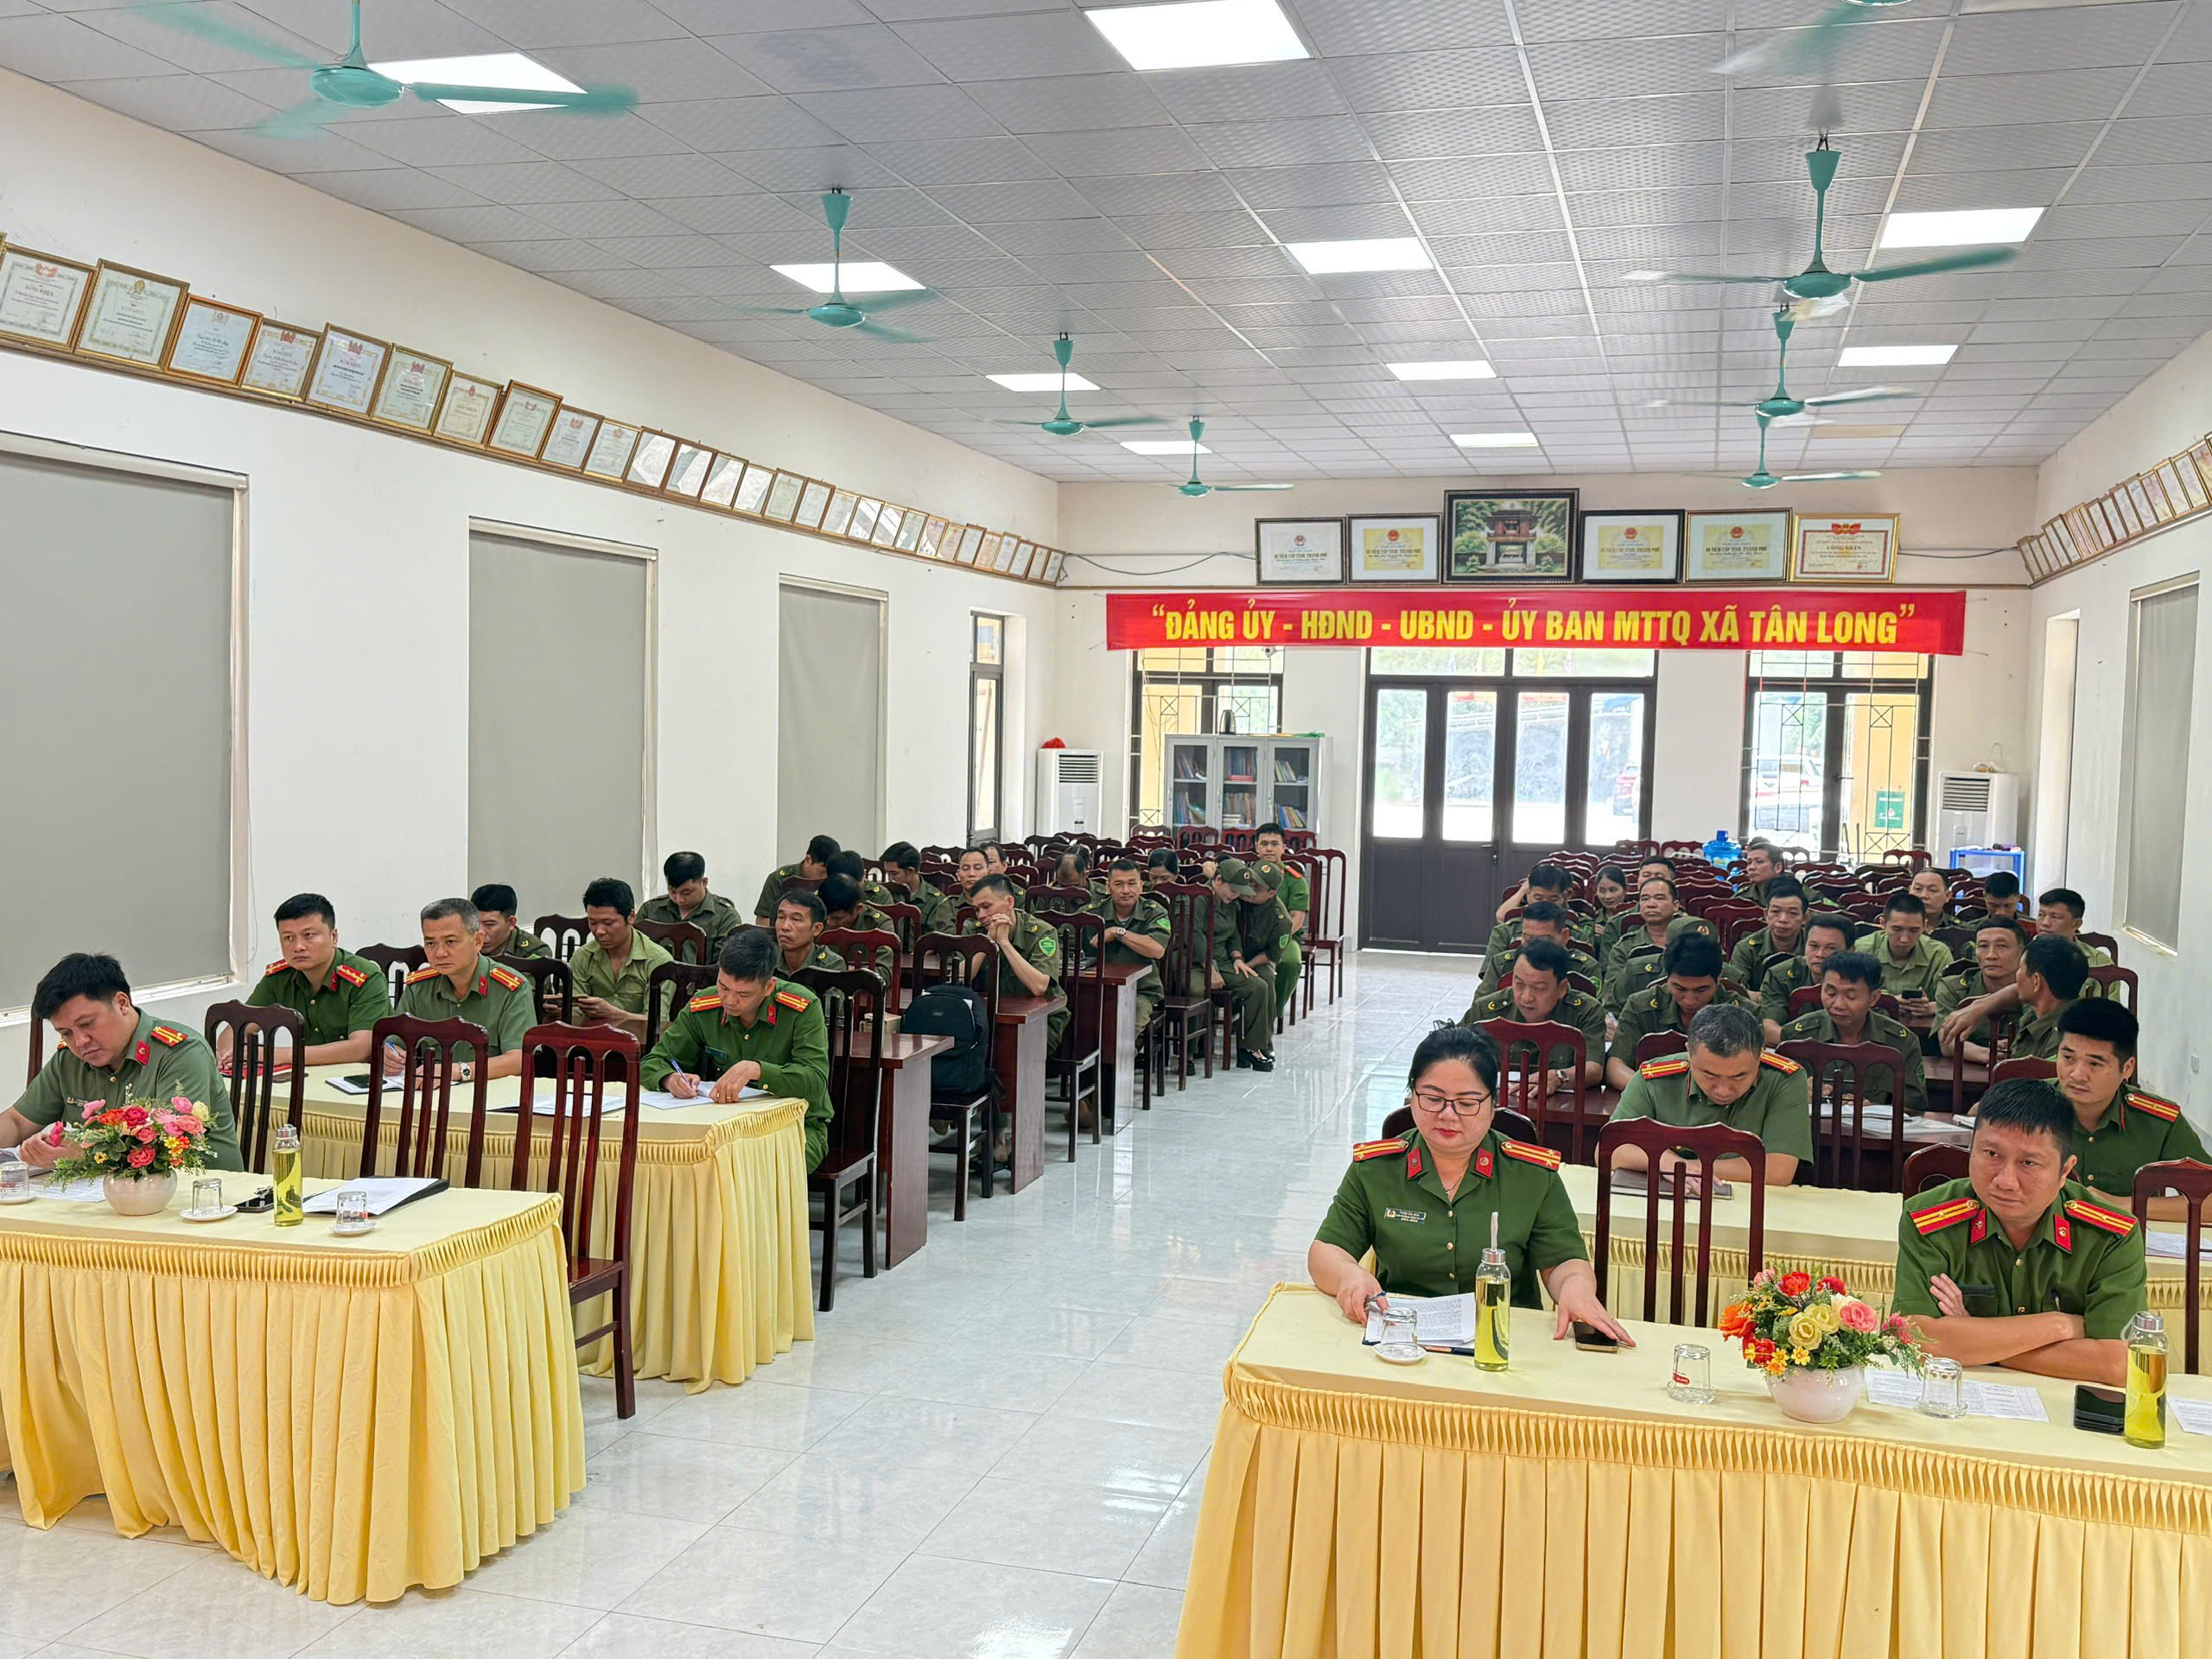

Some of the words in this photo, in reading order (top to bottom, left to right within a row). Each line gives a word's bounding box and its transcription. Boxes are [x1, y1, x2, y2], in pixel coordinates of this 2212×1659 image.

[1152, 598, 1235, 640] “ĐẢNG
[1243, 598, 1275, 640] ỦY
[1301, 610, 1373, 639] HĐND
[1400, 610, 1474, 640] UBND
[1502, 597, 1538, 641] ỦY
[1545, 610, 1605, 641] BAN
[1613, 610, 1691, 645] MTTQ
[1700, 605, 1739, 642] XÃ
[1749, 604, 1808, 643] TÂN
[1816, 604, 1915, 644] LONG”
